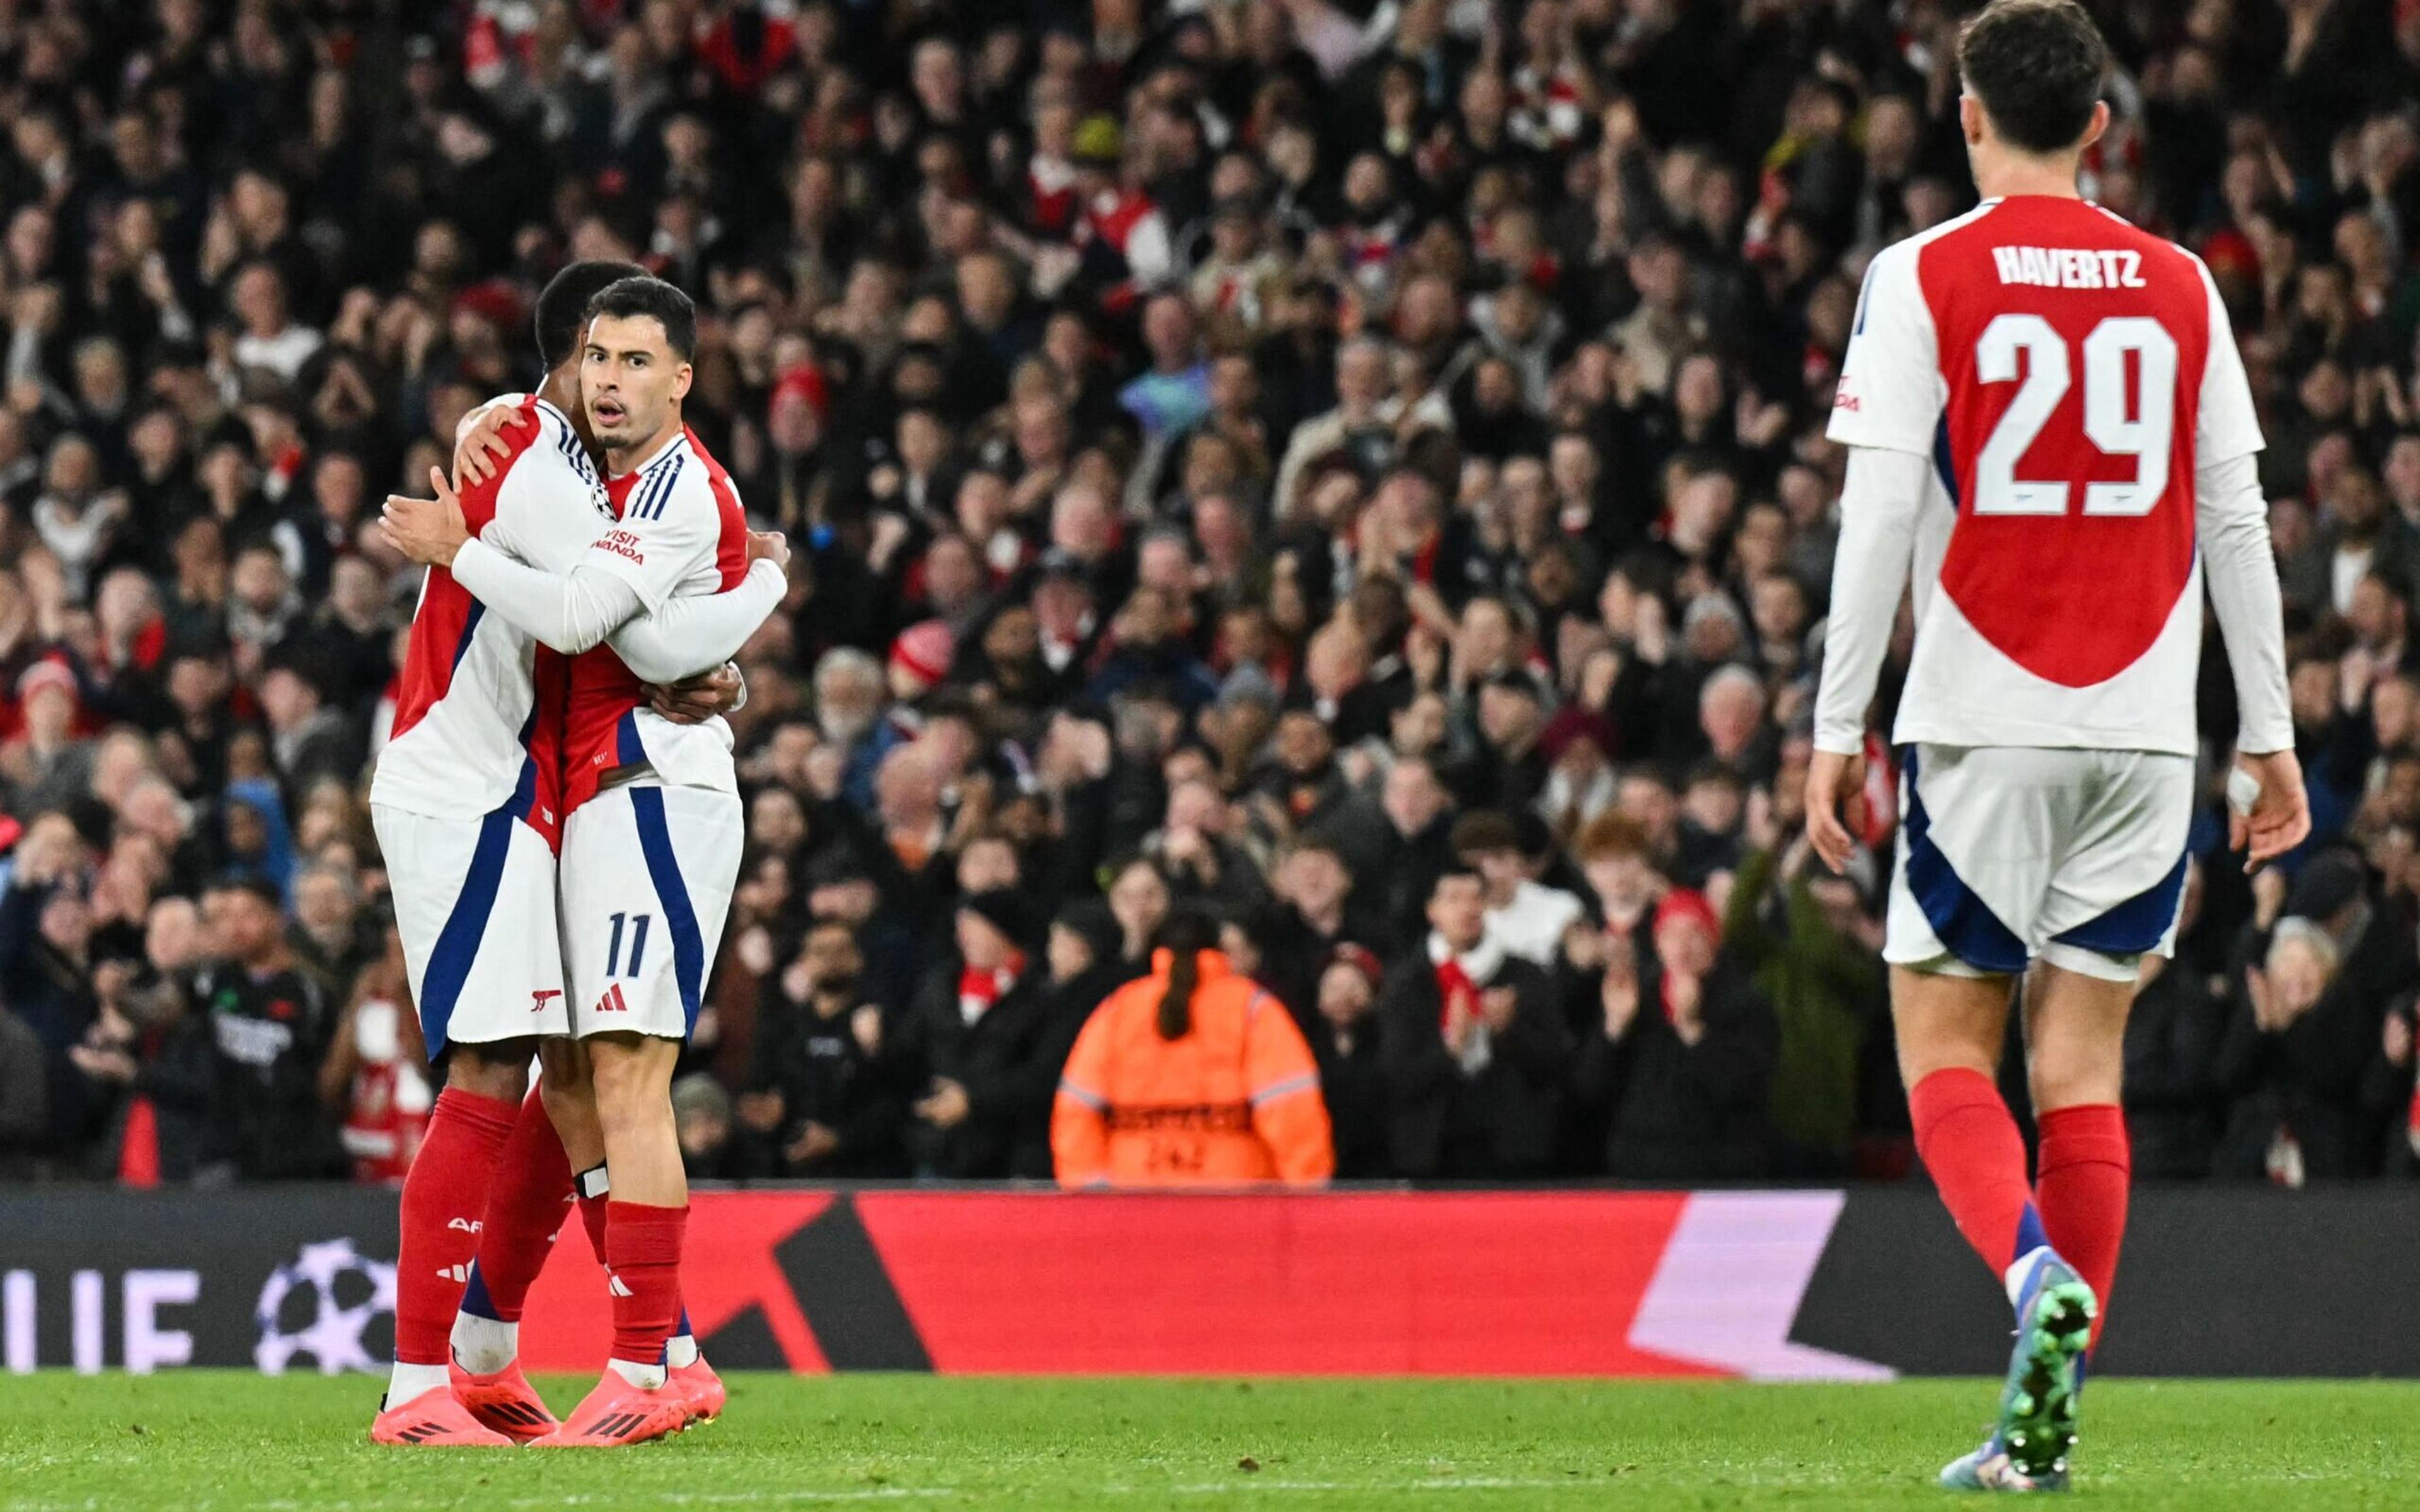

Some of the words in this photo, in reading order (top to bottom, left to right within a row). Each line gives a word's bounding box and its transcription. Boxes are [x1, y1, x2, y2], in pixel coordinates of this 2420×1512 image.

[1991, 246, 2146, 289] HAVERTZ
[1973, 312, 2179, 516] 29
[605, 529, 641, 547] VISIT
[606, 911, 651, 978] 11
